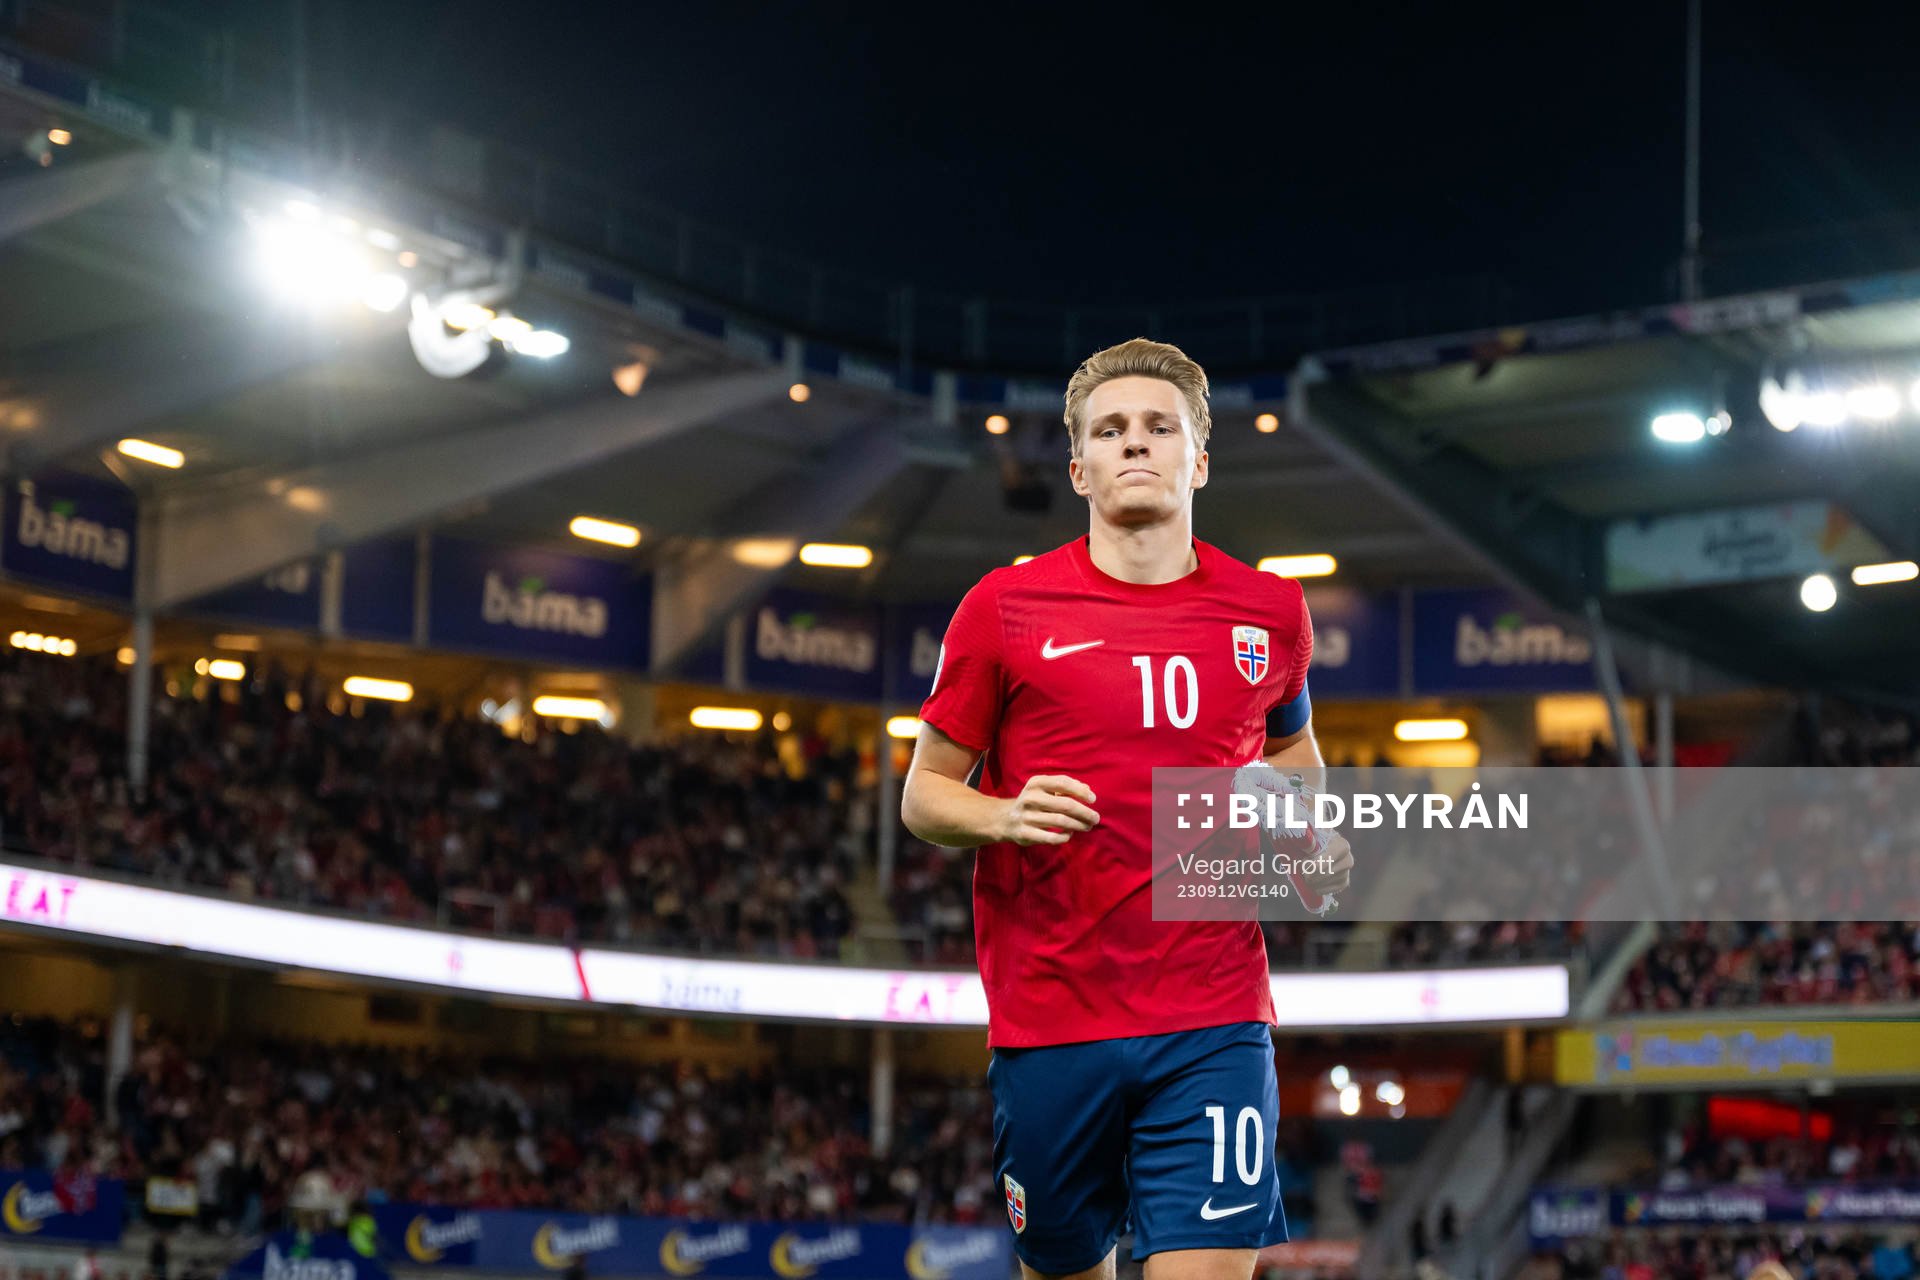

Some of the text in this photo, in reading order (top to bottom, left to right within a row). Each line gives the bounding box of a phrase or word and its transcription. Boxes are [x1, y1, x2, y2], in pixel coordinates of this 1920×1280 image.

[19, 488, 128, 569] bama
[483, 572, 607, 637] bama
[756, 608, 875, 672] bama
[1132, 655, 1199, 729] 10
[1205, 1106, 1264, 1185] 10
